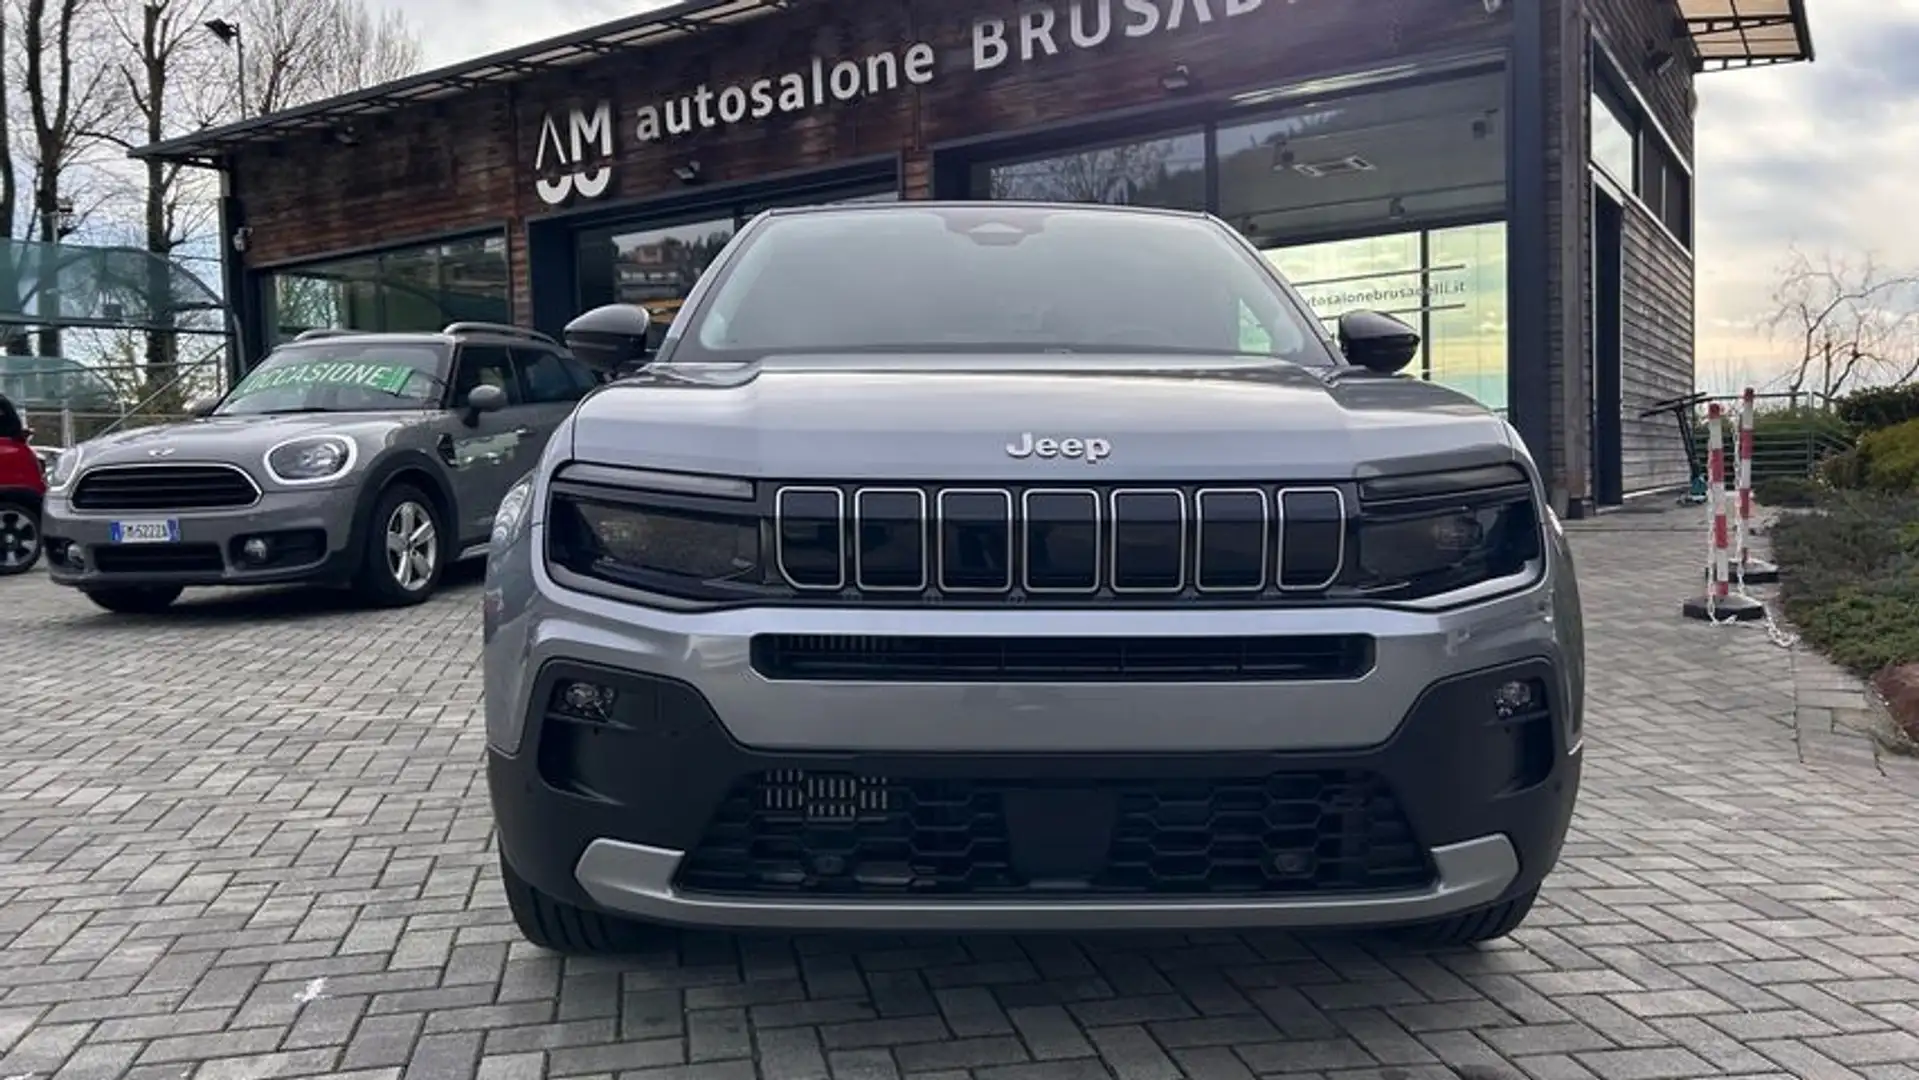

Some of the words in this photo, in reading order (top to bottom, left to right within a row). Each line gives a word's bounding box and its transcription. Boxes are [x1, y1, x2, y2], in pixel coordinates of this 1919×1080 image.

[636, 42, 935, 142] autosalone
[972, 0, 1297, 71] BRUSA
[1006, 432, 1111, 463] Jeep
